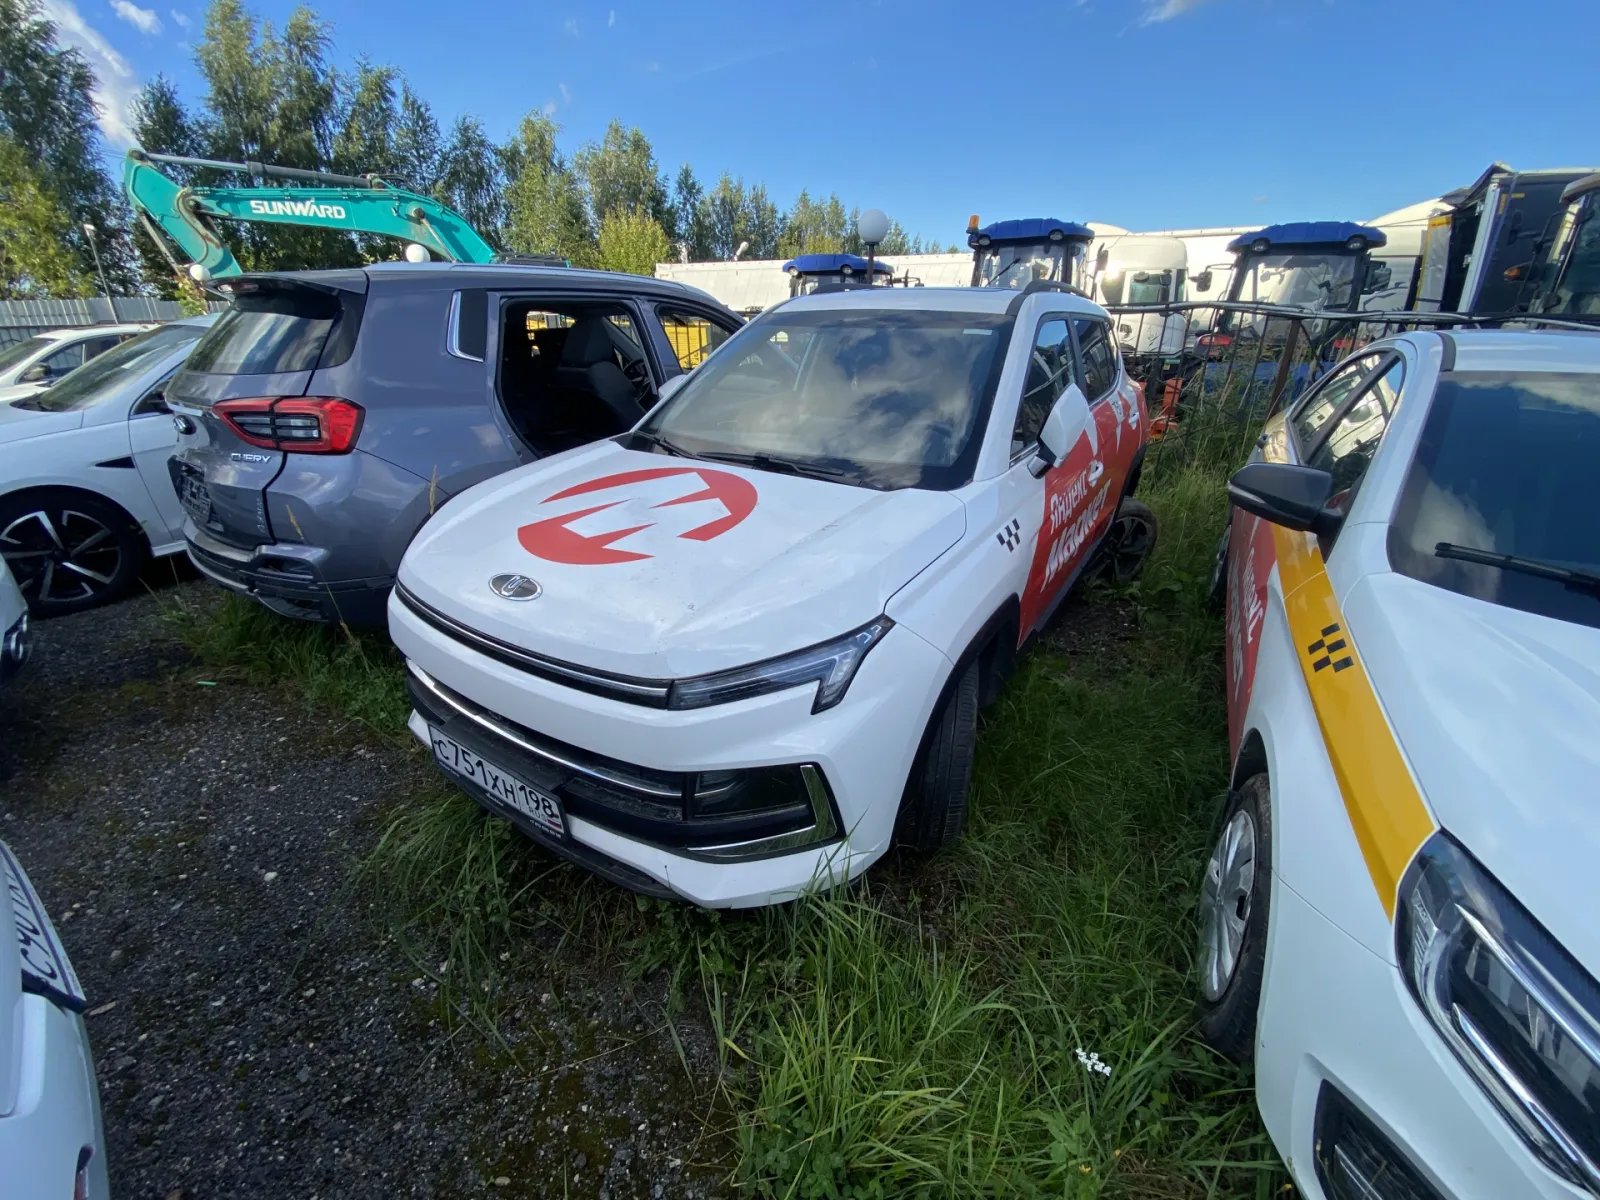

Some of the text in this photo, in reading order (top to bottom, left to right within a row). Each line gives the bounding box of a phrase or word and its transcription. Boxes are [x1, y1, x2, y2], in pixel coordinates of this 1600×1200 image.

[250, 198, 346, 219] SUNWARD
[231, 453, 272, 464] CHERY
[1040, 478, 1111, 593] Маркет
[519, 784, 555, 818] 198
